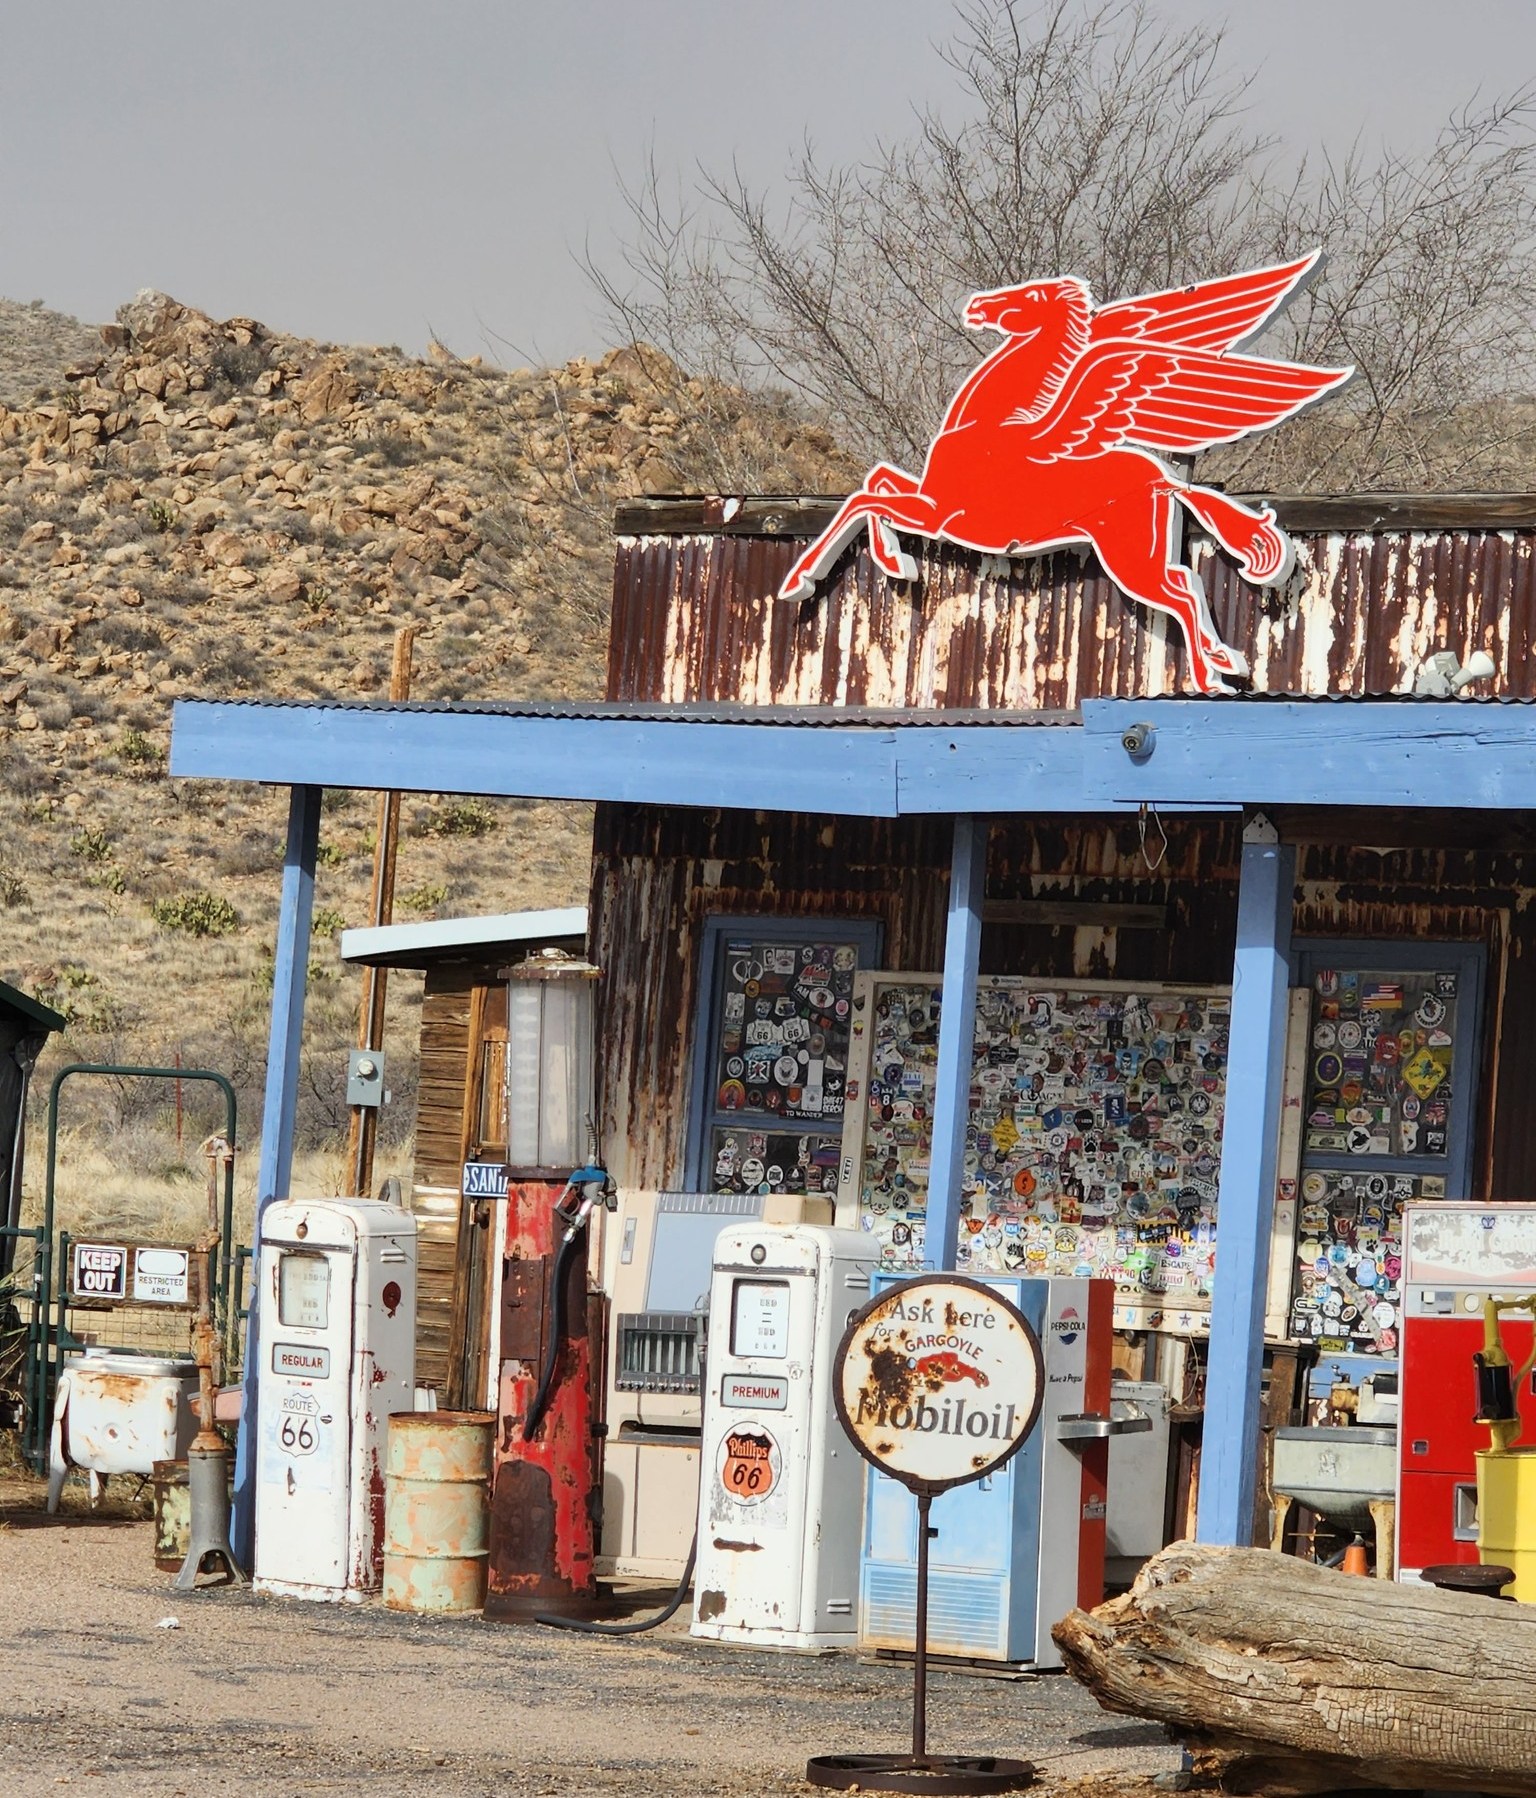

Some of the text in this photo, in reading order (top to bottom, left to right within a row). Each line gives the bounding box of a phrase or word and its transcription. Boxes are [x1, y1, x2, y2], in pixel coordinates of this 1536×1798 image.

[757, 1032, 769, 1040] 66
[787, 1029, 799, 1038] 66
[842, 1158, 853, 1181] YETI
[80, 1250, 121, 1272] KEEP
[84, 1271, 116, 1291] OUT
[138, 1275, 184, 1286] RESTRICTED
[151, 1287, 171, 1296] AREA
[889, 1298, 996, 1329] Ask here
[872, 1322, 895, 1338] for
[904, 1334, 984, 1360] GARGOYLE
[281, 1354, 324, 1369] REGULAR
[1067, 1373, 1083, 1384] Pepsi
[732, 1385, 780, 1399] PREMIUM
[283, 1398, 313, 1412] ROUTE
[855, 1387, 1016, 1441] Mobiloil
[281, 1417, 314, 1450] 66
[728, 1437, 769, 1459] Phillips
[732, 1463, 762, 1490] 66
